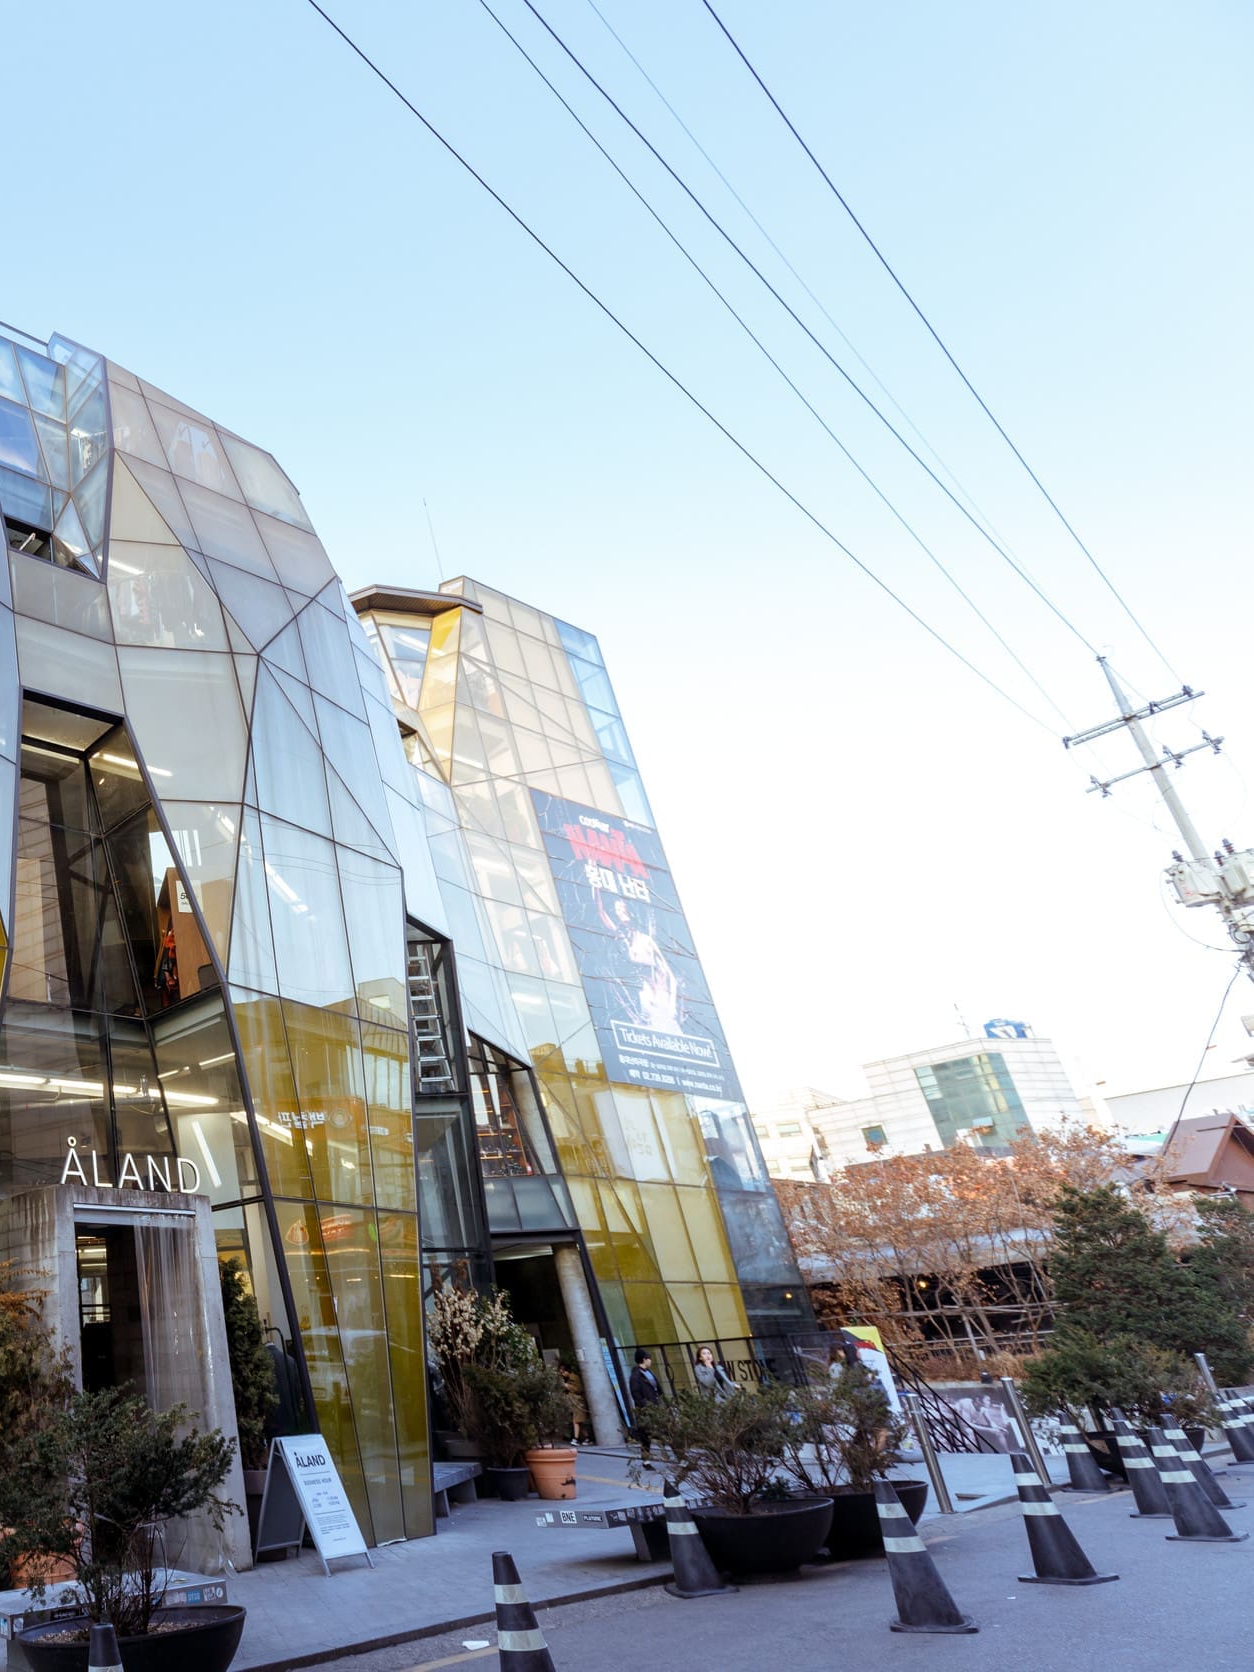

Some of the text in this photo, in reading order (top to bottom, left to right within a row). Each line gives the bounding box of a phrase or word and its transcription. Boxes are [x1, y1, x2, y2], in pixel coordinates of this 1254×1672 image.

[584, 860, 651, 903] 홍대 난타
[618, 1027, 713, 1058] Tickets Available Now!
[60, 1136, 201, 1194] ÅLAND
[293, 1451, 327, 1468] ÅLAND
[561, 1511, 576, 1523] BNE
